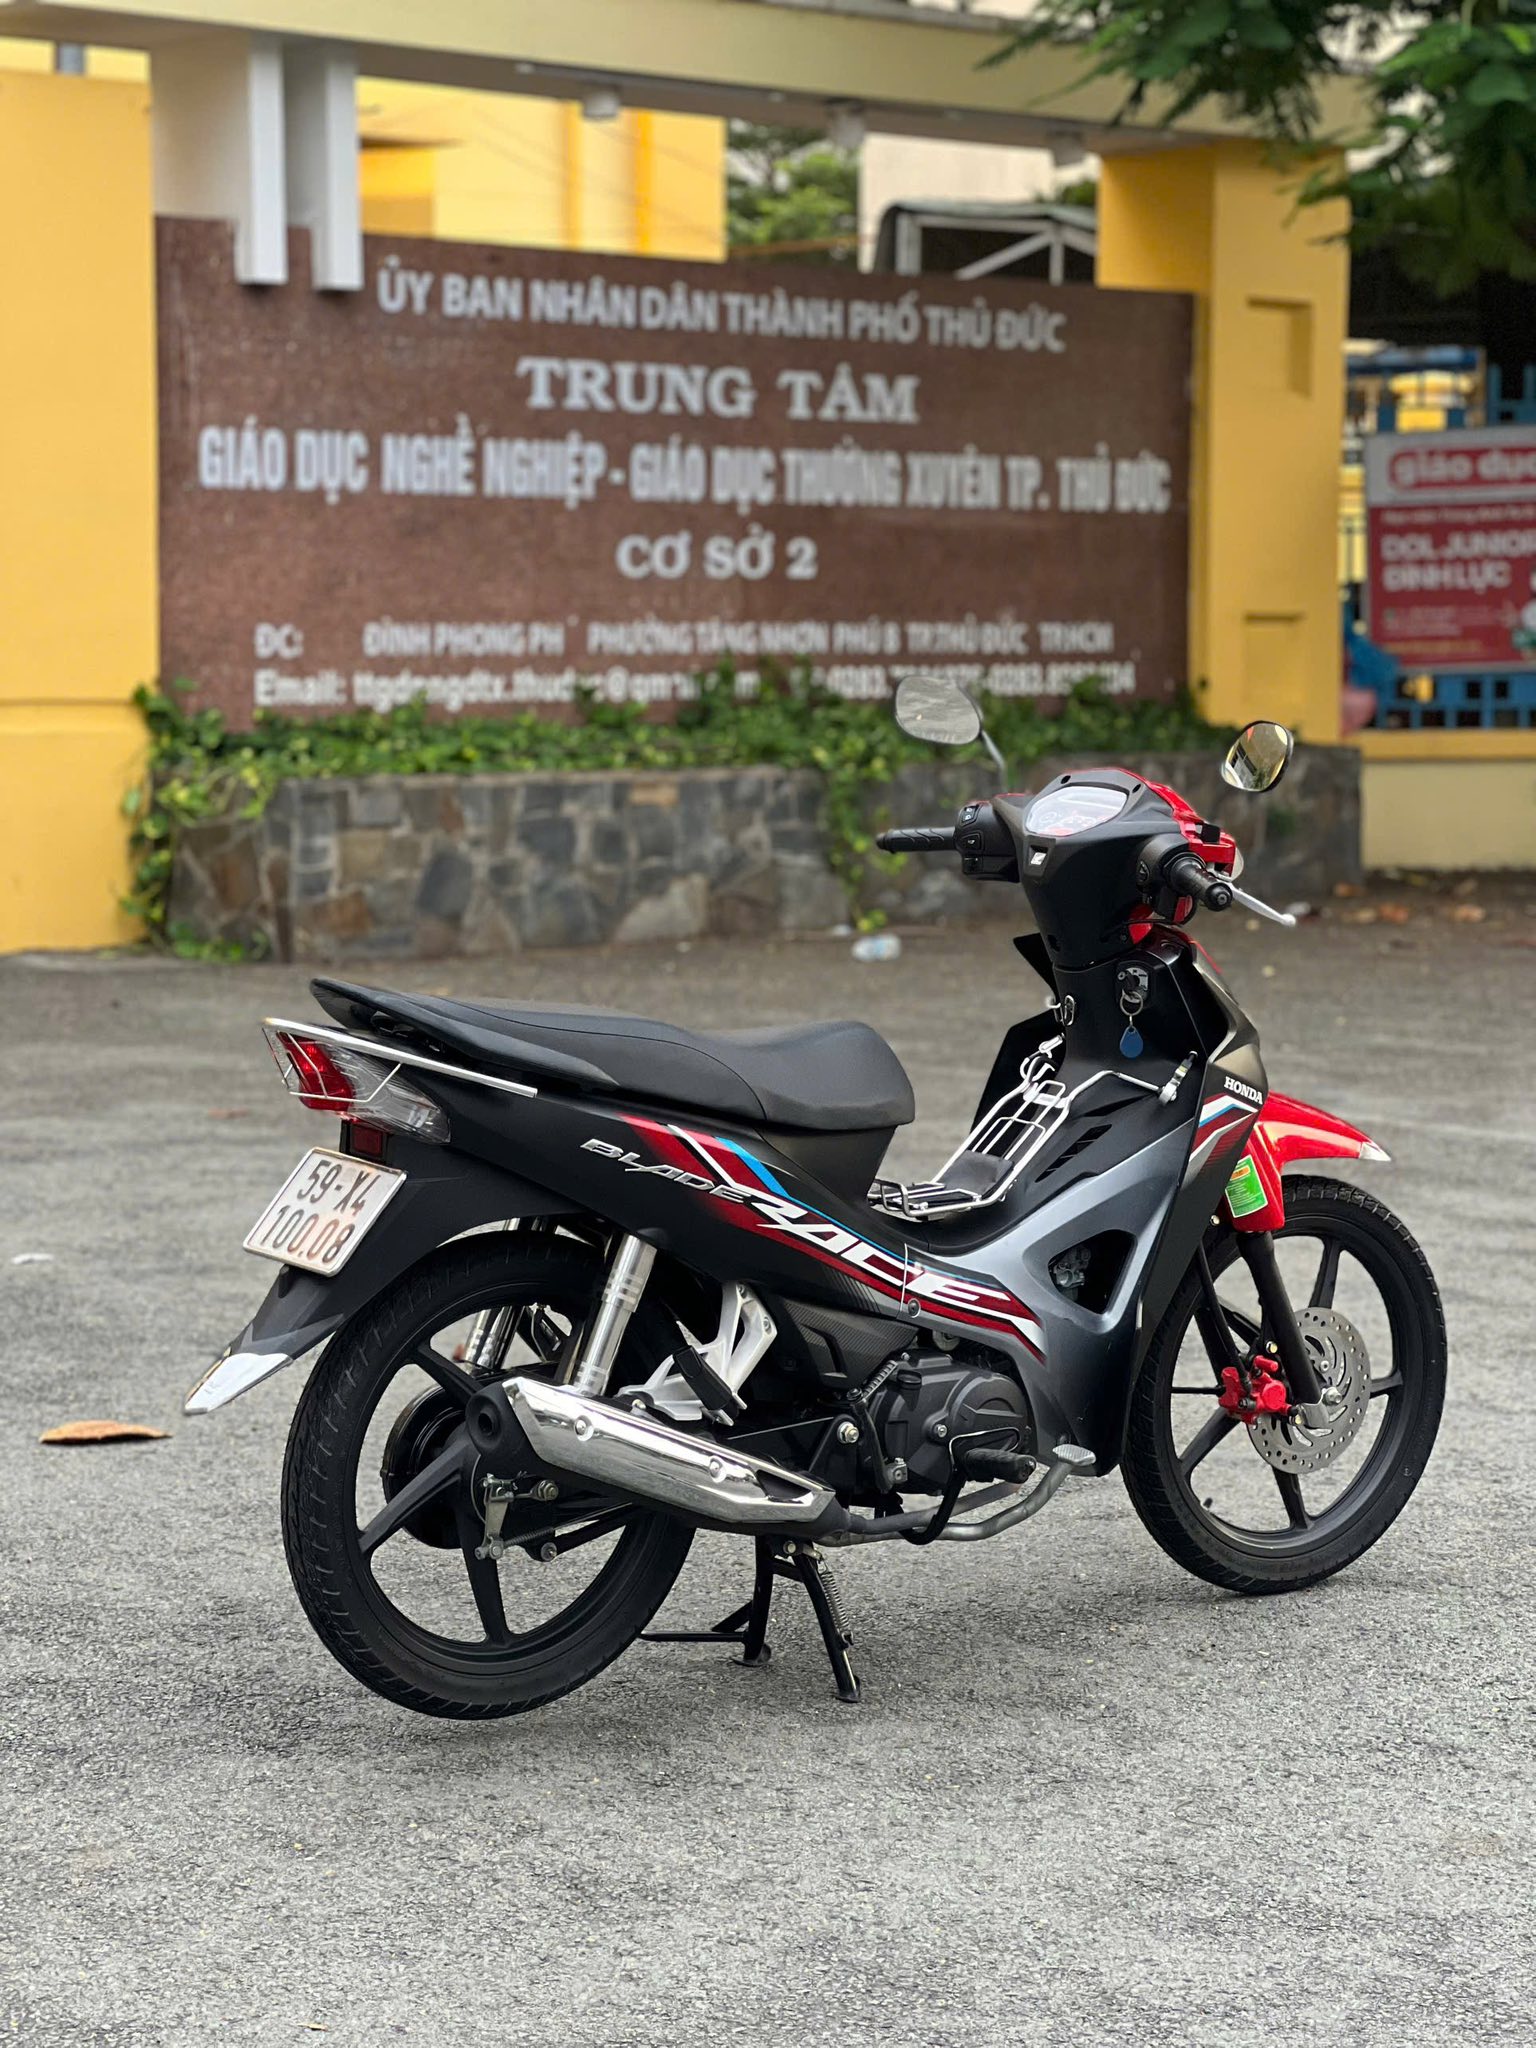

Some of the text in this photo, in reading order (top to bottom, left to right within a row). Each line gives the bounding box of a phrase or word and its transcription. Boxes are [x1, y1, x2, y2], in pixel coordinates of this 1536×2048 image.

[376, 254, 1067, 353] ỦY BAN NHÂN DÂN THÀNH PHỐ THỦ ĐỨC
[515, 355, 921, 424] TRUNG TÂM
[198, 414, 286, 490] GIÁO
[295, 429, 369, 504] DỤC
[381, 412, 477, 496] NGHỀ
[483, 429, 608, 510] NGHIỆP
[629, 433, 706, 503] GIÁO
[711, 446, 776, 516] DỤC
[781, 435, 902, 508] THƯỜNG
[905, 443, 1000, 509] XUYÊN
[1005, 455, 1051, 512] TP.
[1056, 441, 1111, 513] THỦ
[1114, 449, 1172, 514] ĐỨC
[615, 522, 818, 580] CƠ SỞ 2
[254, 668, 347, 705] Email:
[1223, 1076, 1264, 1105] HONDA
[296, 1159, 381, 1217] 59-X4
[580, 1138, 754, 1203] BLADE
[260, 1204, 356, 1263] 100.08
[743, 1183, 1012, 1302] RACE
